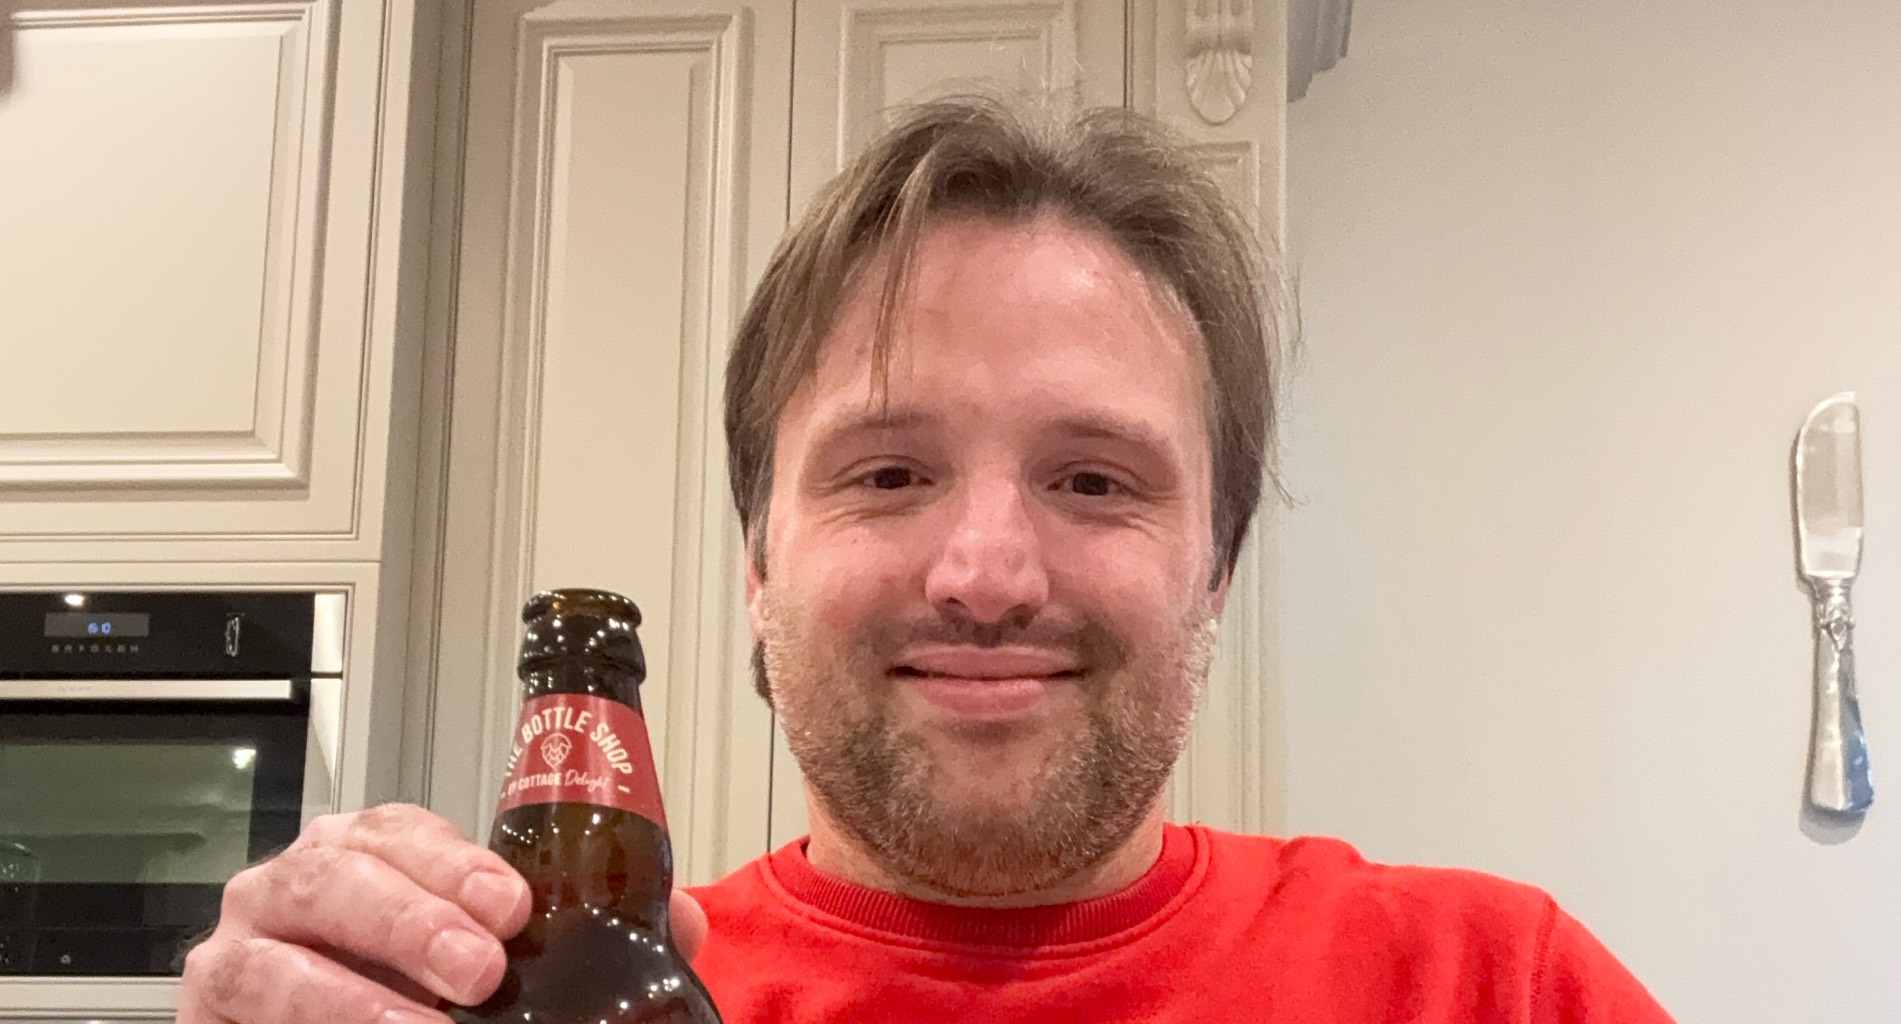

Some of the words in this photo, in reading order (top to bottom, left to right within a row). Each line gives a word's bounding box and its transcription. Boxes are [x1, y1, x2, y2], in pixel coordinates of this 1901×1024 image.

[521, 706, 592, 743] BOTTLE
[589, 722, 633, 774] SHOP
[518, 772, 562, 791] COTTAGE
[564, 769, 611, 792] Delight
